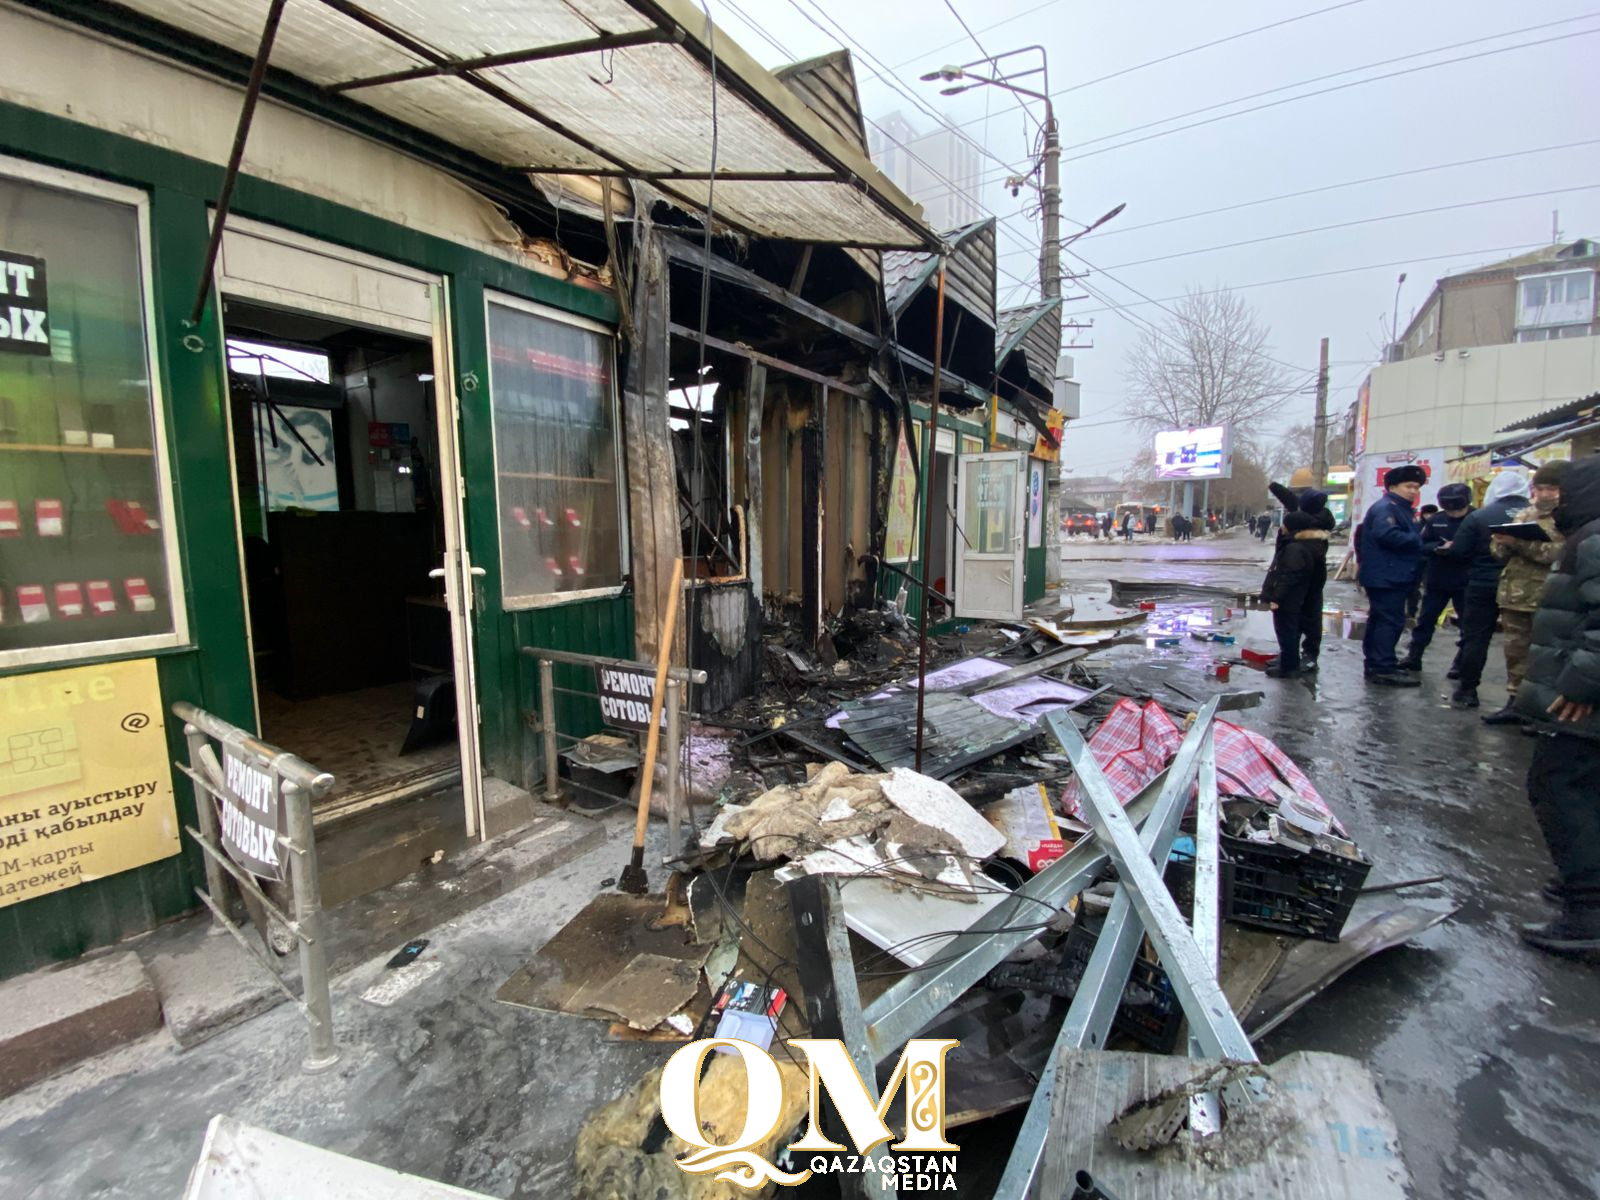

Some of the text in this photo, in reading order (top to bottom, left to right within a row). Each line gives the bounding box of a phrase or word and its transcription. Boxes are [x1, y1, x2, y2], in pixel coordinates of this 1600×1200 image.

[0, 780, 158, 828] ны ауыстыру
[227, 754, 272, 813] РЕМОНТ
[35, 802, 145, 840] қабылдау
[222, 797, 279, 866] СОТОВЫХ
[0, 842, 95, 876] М-карты
[0, 861, 82, 897] атежей
